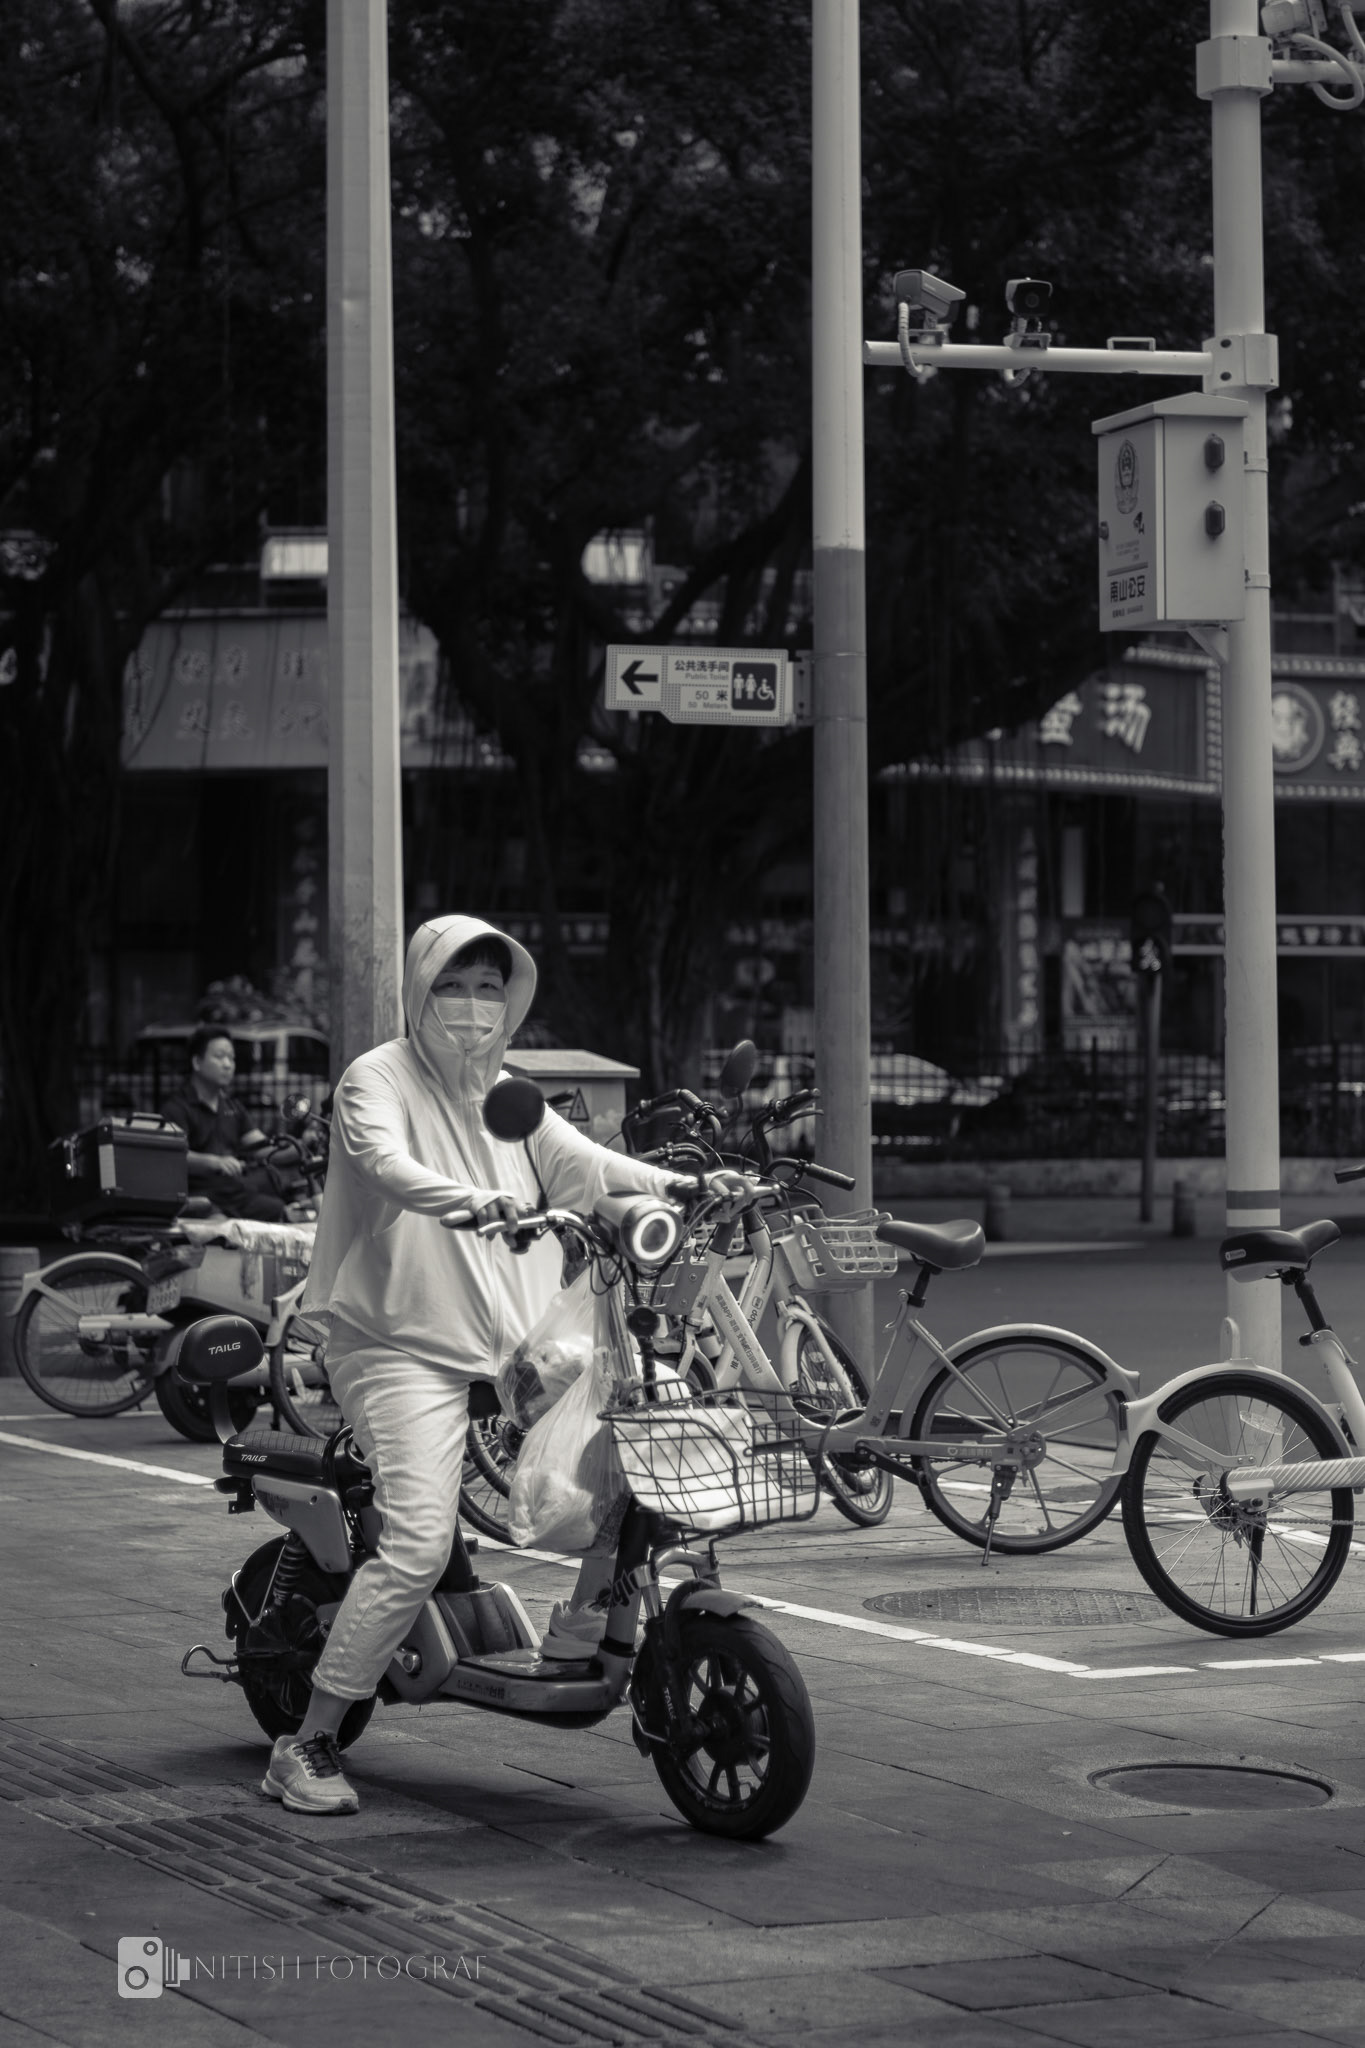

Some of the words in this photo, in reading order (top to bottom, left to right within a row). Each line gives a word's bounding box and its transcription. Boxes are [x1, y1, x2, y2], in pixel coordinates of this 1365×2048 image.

[675, 660, 729, 672] 公共洗手间
[695, 690, 710, 701] 50
[716, 689, 729, 702] 米
[208, 1341, 241, 1356] TAILG
[241, 1453, 268, 1463] TAILG
